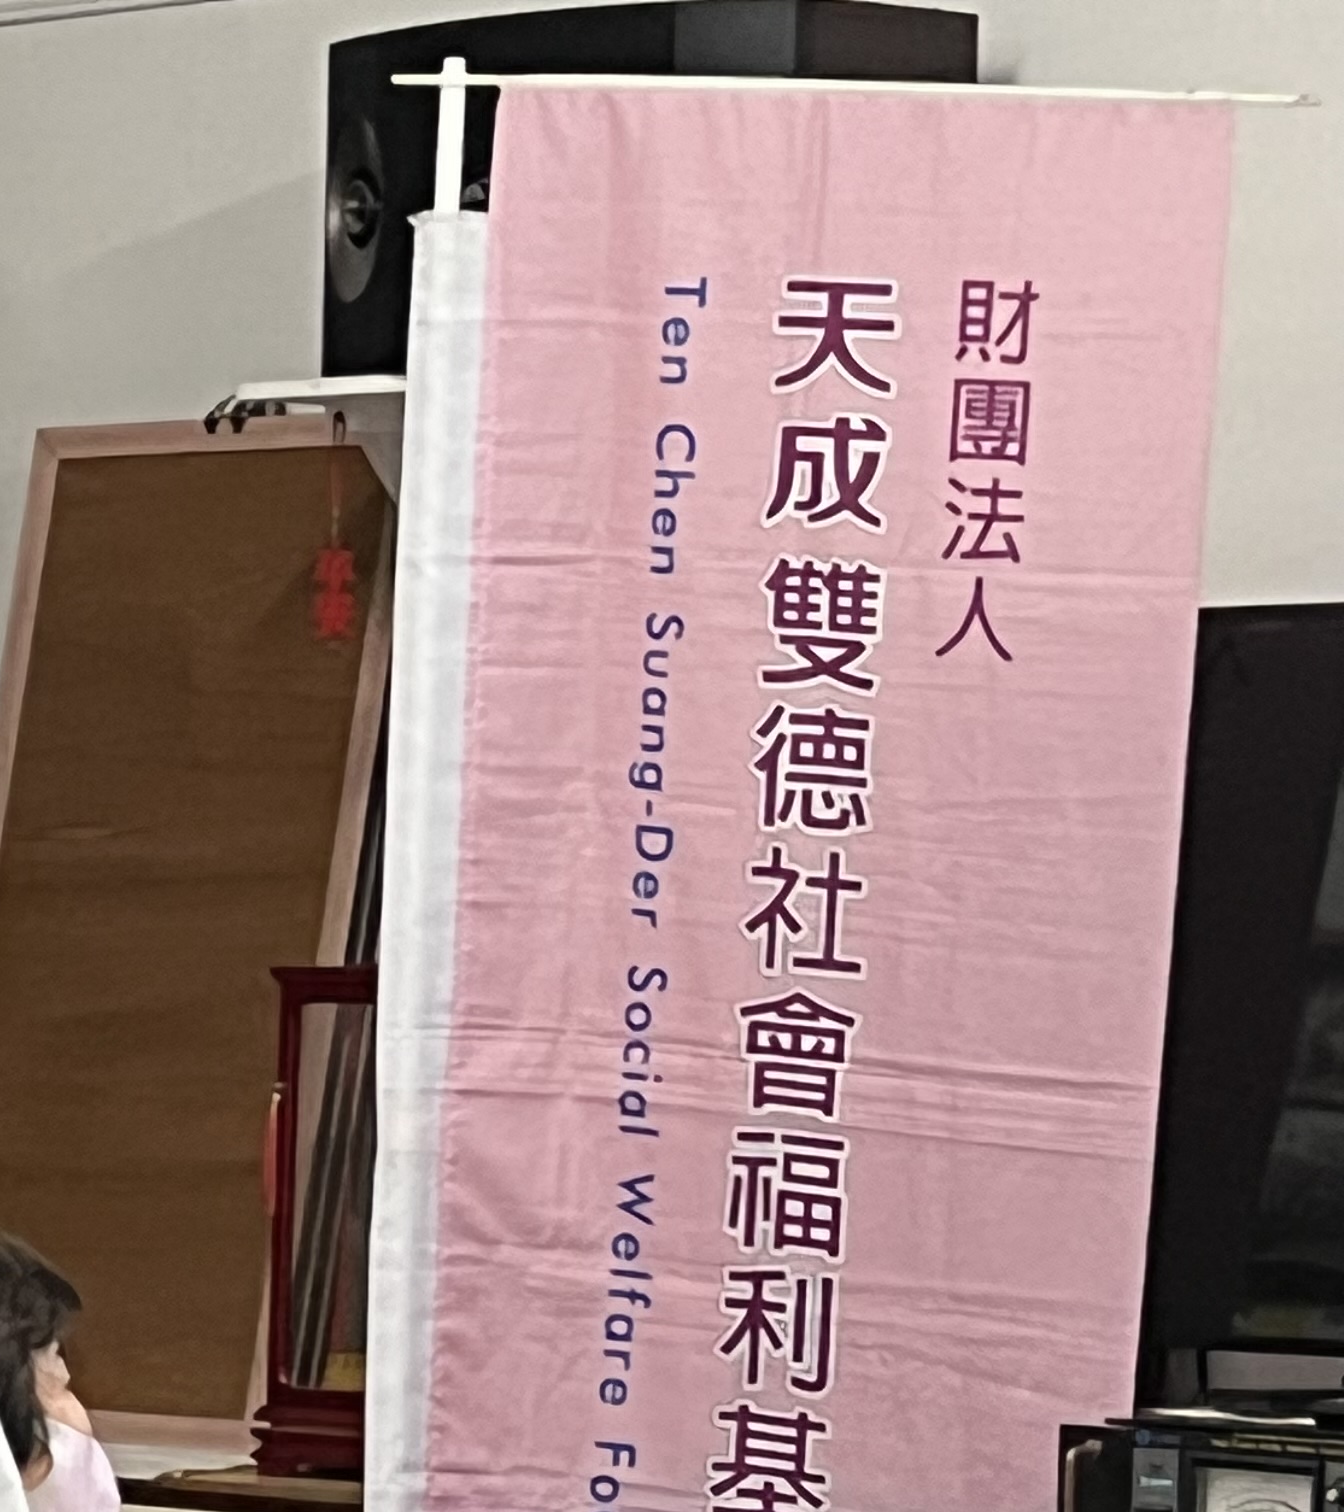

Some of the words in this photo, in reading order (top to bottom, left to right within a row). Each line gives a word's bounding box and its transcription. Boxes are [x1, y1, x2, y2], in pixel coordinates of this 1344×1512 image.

[660, 277, 707, 384] Ten
[650, 424, 696, 575] Chen
[935, 280, 1039, 661] 財團法人
[628, 612, 685, 929] Suang-Der
[617, 965, 668, 1138] Social
[599, 1174, 655, 1406] Welfare
